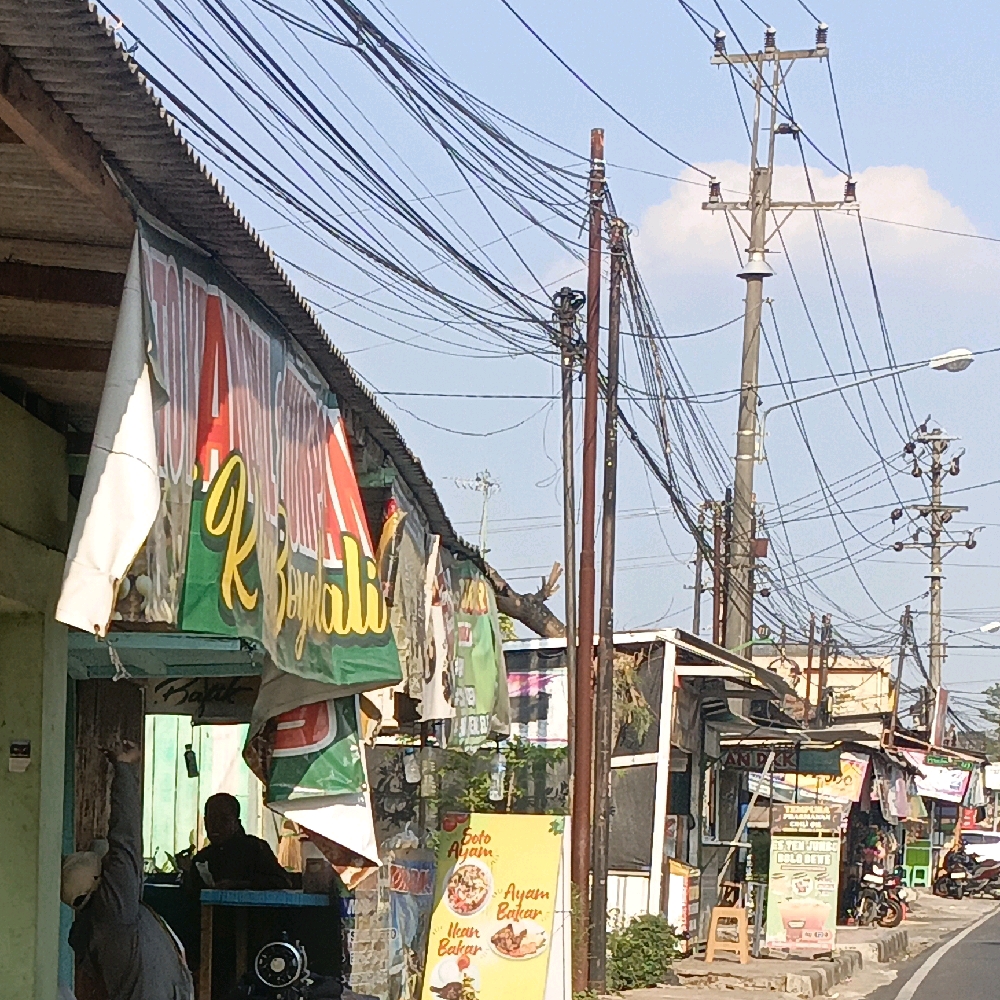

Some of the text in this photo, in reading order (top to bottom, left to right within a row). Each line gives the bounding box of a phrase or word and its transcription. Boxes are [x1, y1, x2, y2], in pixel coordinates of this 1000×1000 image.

[462, 827, 491, 845] Soto
[447, 841, 493, 864] Ayam
[504, 883, 550, 910] Ayam
[497, 902, 543, 922] Bakar
[448, 922, 481, 938] Ikan
[438, 938, 482, 957] Bakar
